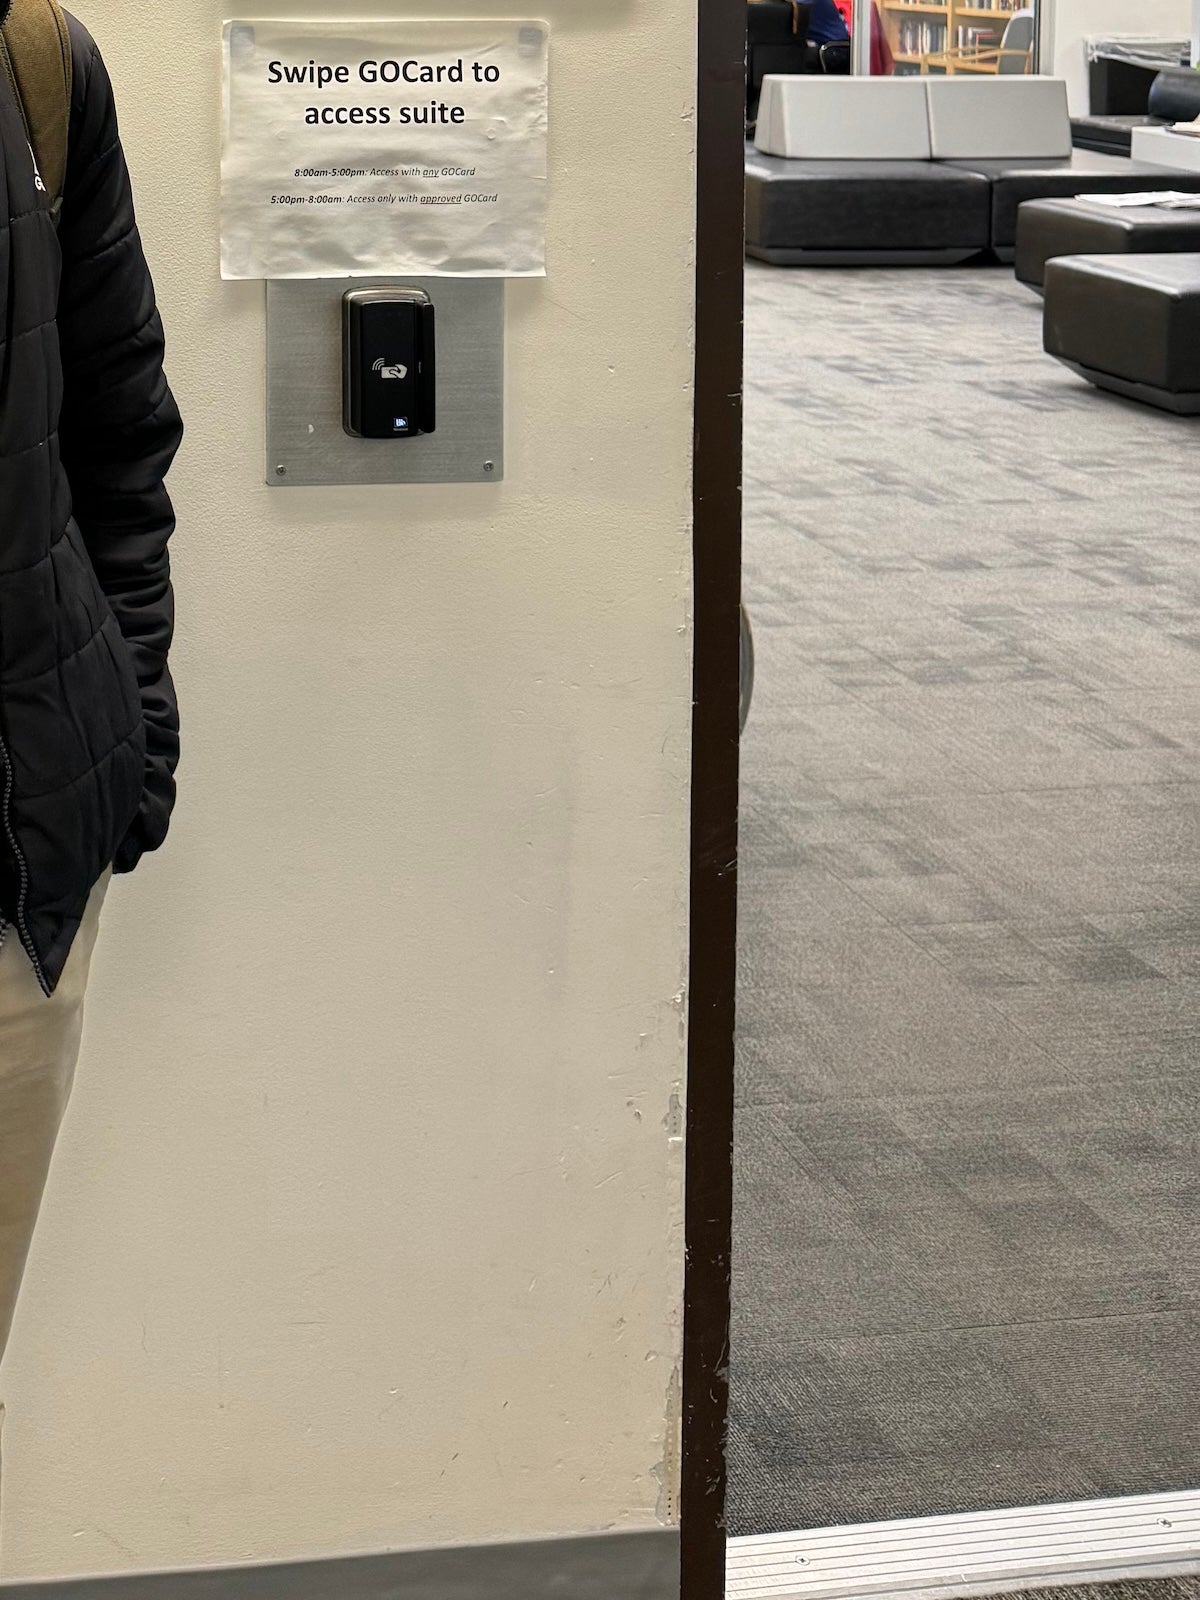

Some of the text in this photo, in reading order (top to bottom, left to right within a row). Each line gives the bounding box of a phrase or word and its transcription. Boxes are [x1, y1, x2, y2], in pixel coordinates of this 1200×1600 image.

[267, 59, 500, 88] Swipe GOCard to
[304, 100, 465, 125] access suite
[369, 167, 399, 176] Access
[401, 167, 420, 176] with
[422, 168, 439, 178] any
[441, 167, 476, 176] GOCard
[346, 195, 376, 203] Access
[377, 194, 397, 204] only
[398, 194, 418, 203] with
[420, 194, 462, 205] approved
[463, 193, 498, 202] GOCard
